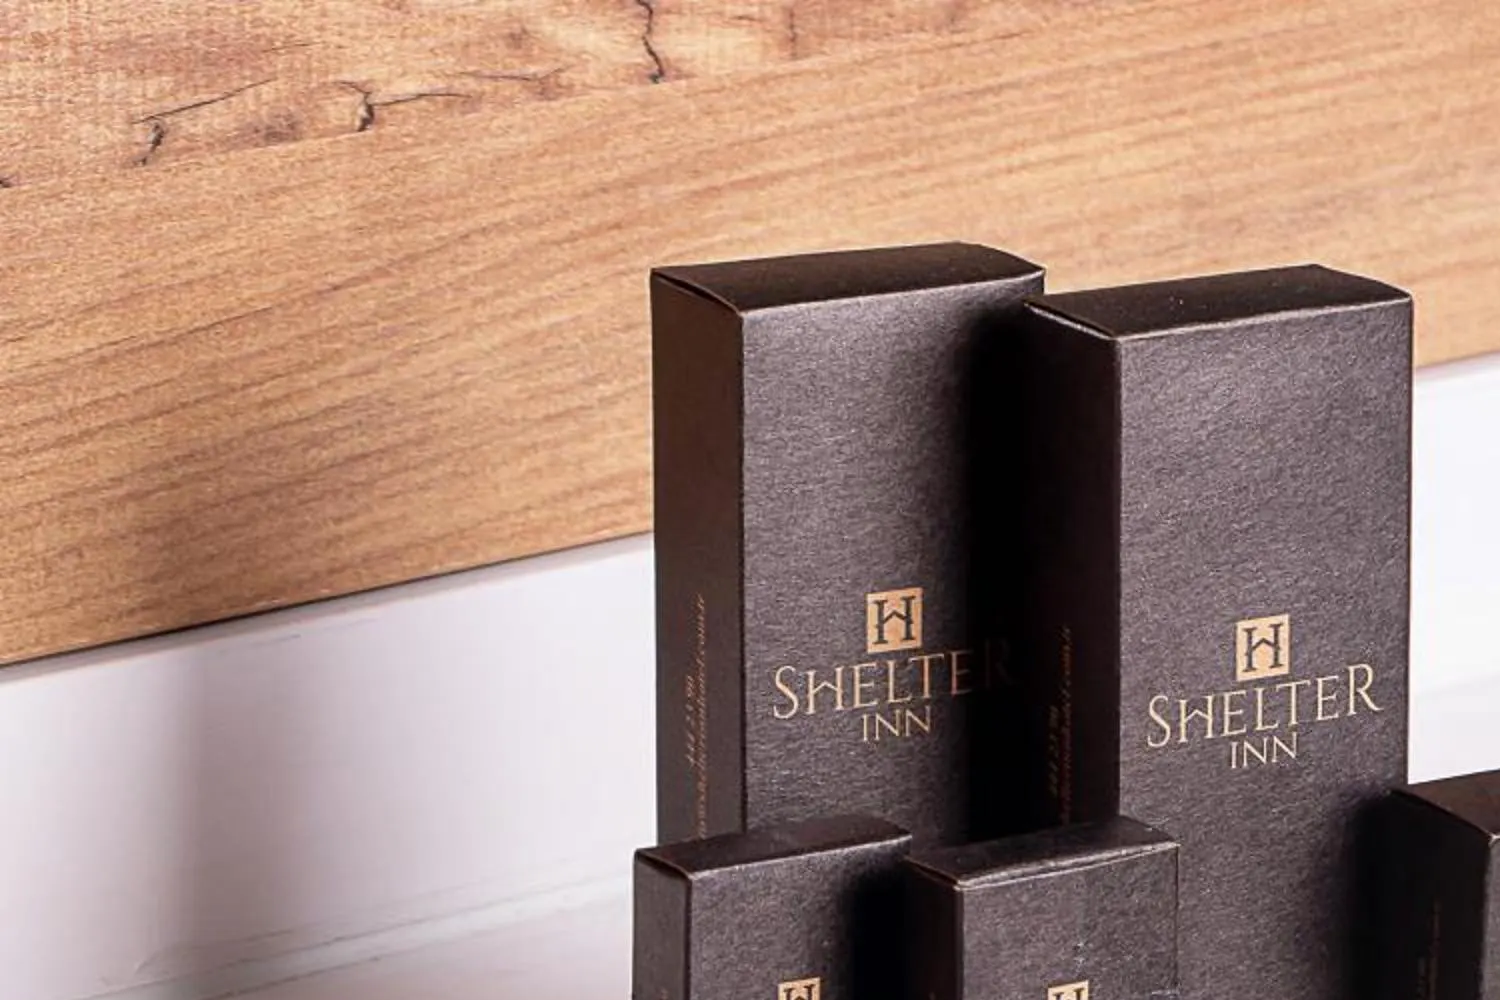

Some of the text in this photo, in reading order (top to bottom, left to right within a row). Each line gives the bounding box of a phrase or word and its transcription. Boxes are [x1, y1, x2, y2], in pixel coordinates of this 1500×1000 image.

[862, 705, 932, 743] INN
[1147, 663, 1384, 748] SHELTER
[1230, 732, 1298, 769] INN
